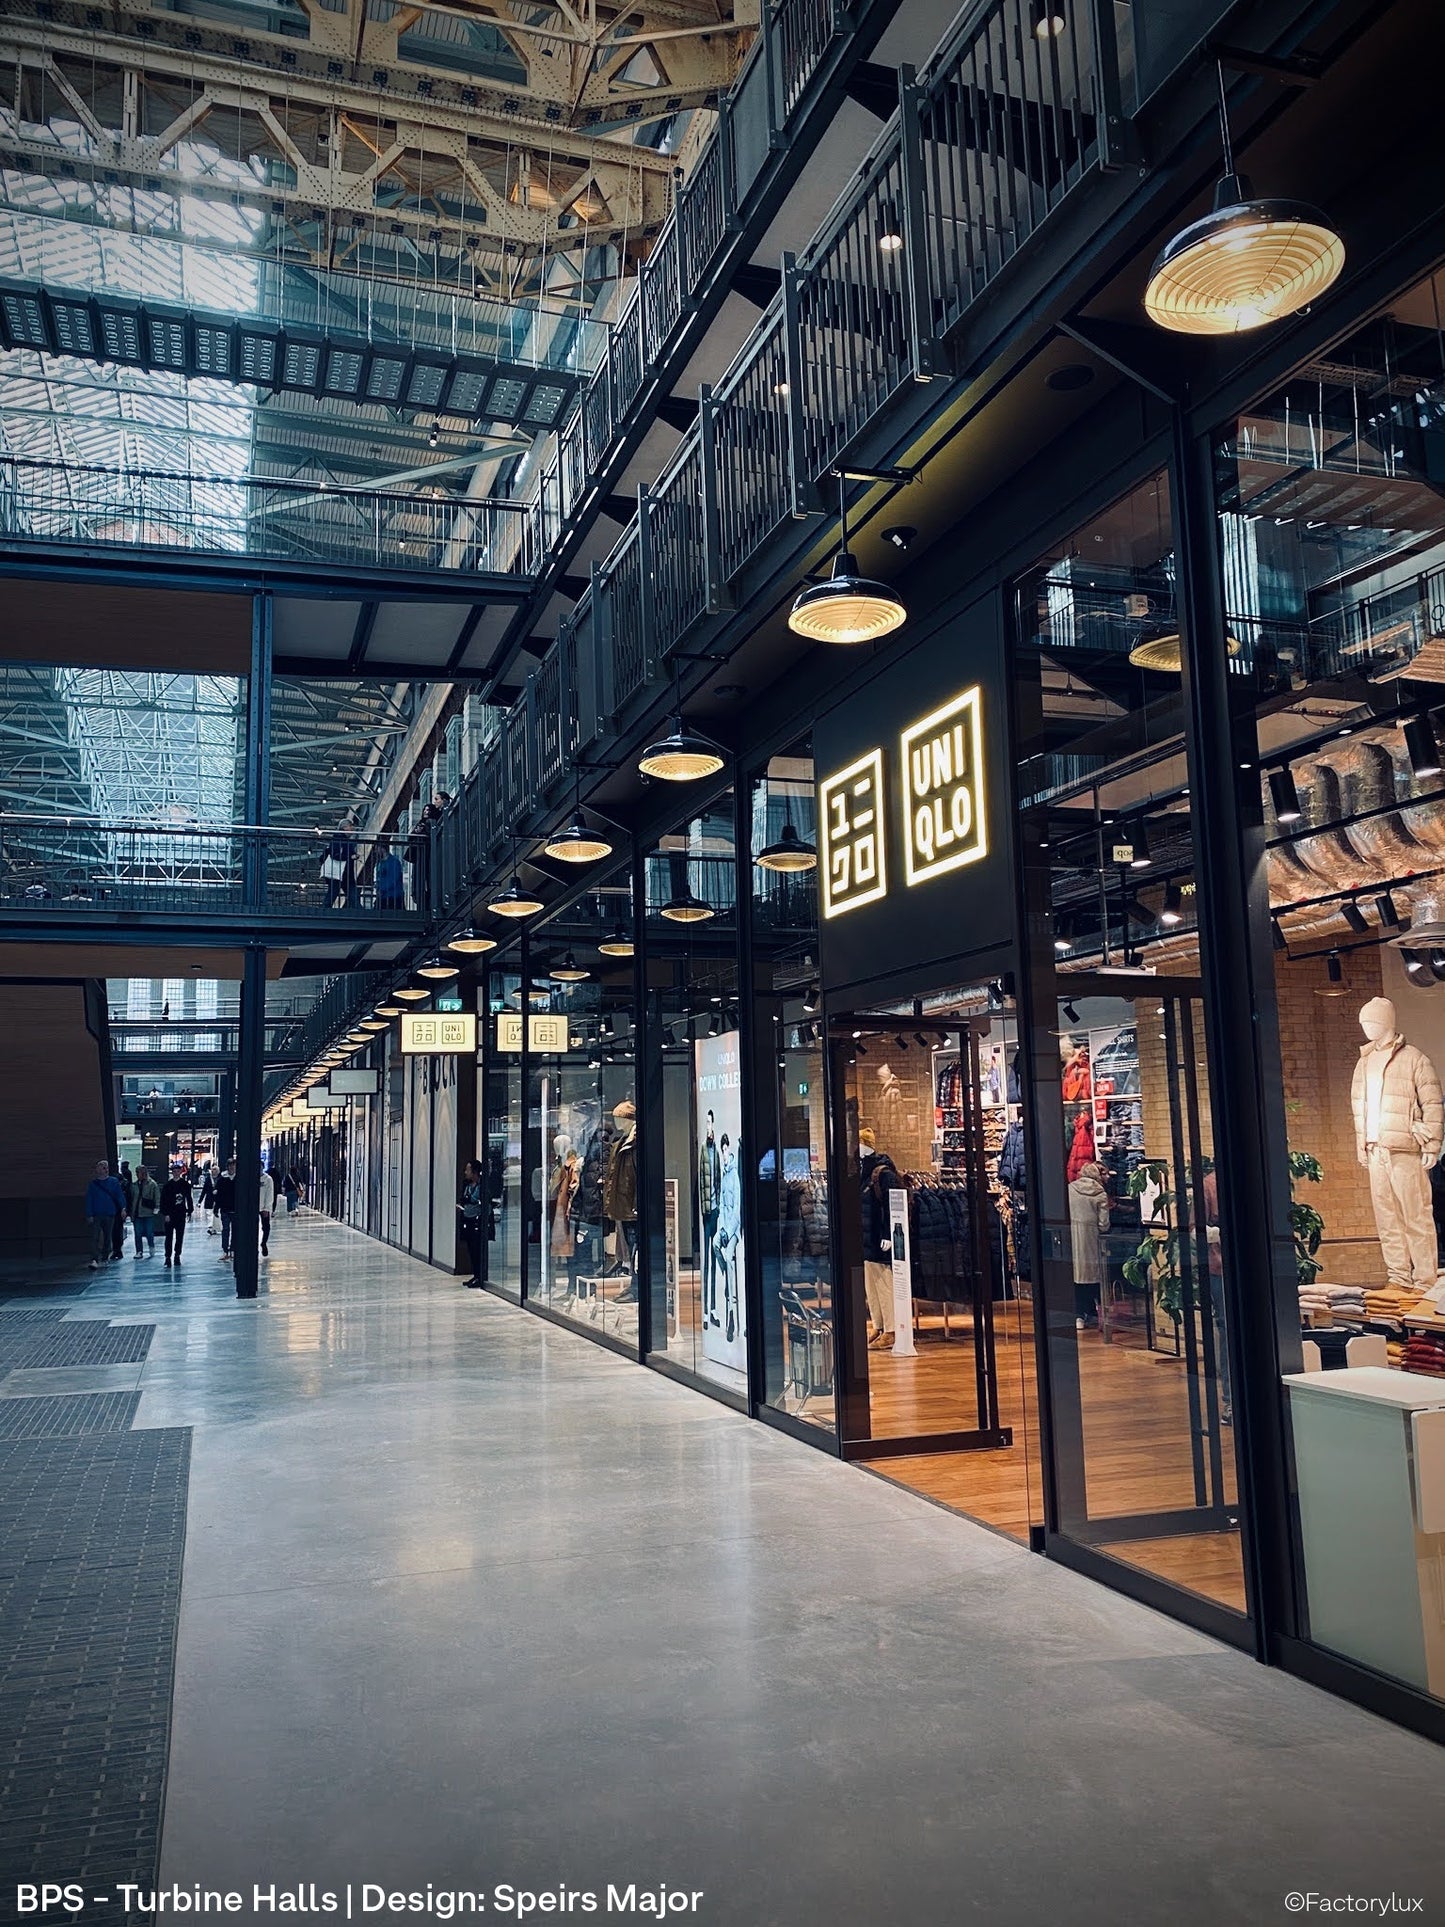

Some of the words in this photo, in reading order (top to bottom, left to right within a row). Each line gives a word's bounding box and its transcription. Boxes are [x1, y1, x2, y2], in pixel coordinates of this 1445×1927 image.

[912, 724, 966, 796] UNI
[831, 777, 874, 840] ユニ
[831, 783, 876, 895] クロ
[915, 786, 972, 861] QLO
[444, 1024, 460, 1032] UNI
[444, 1033, 462, 1042] QLO
